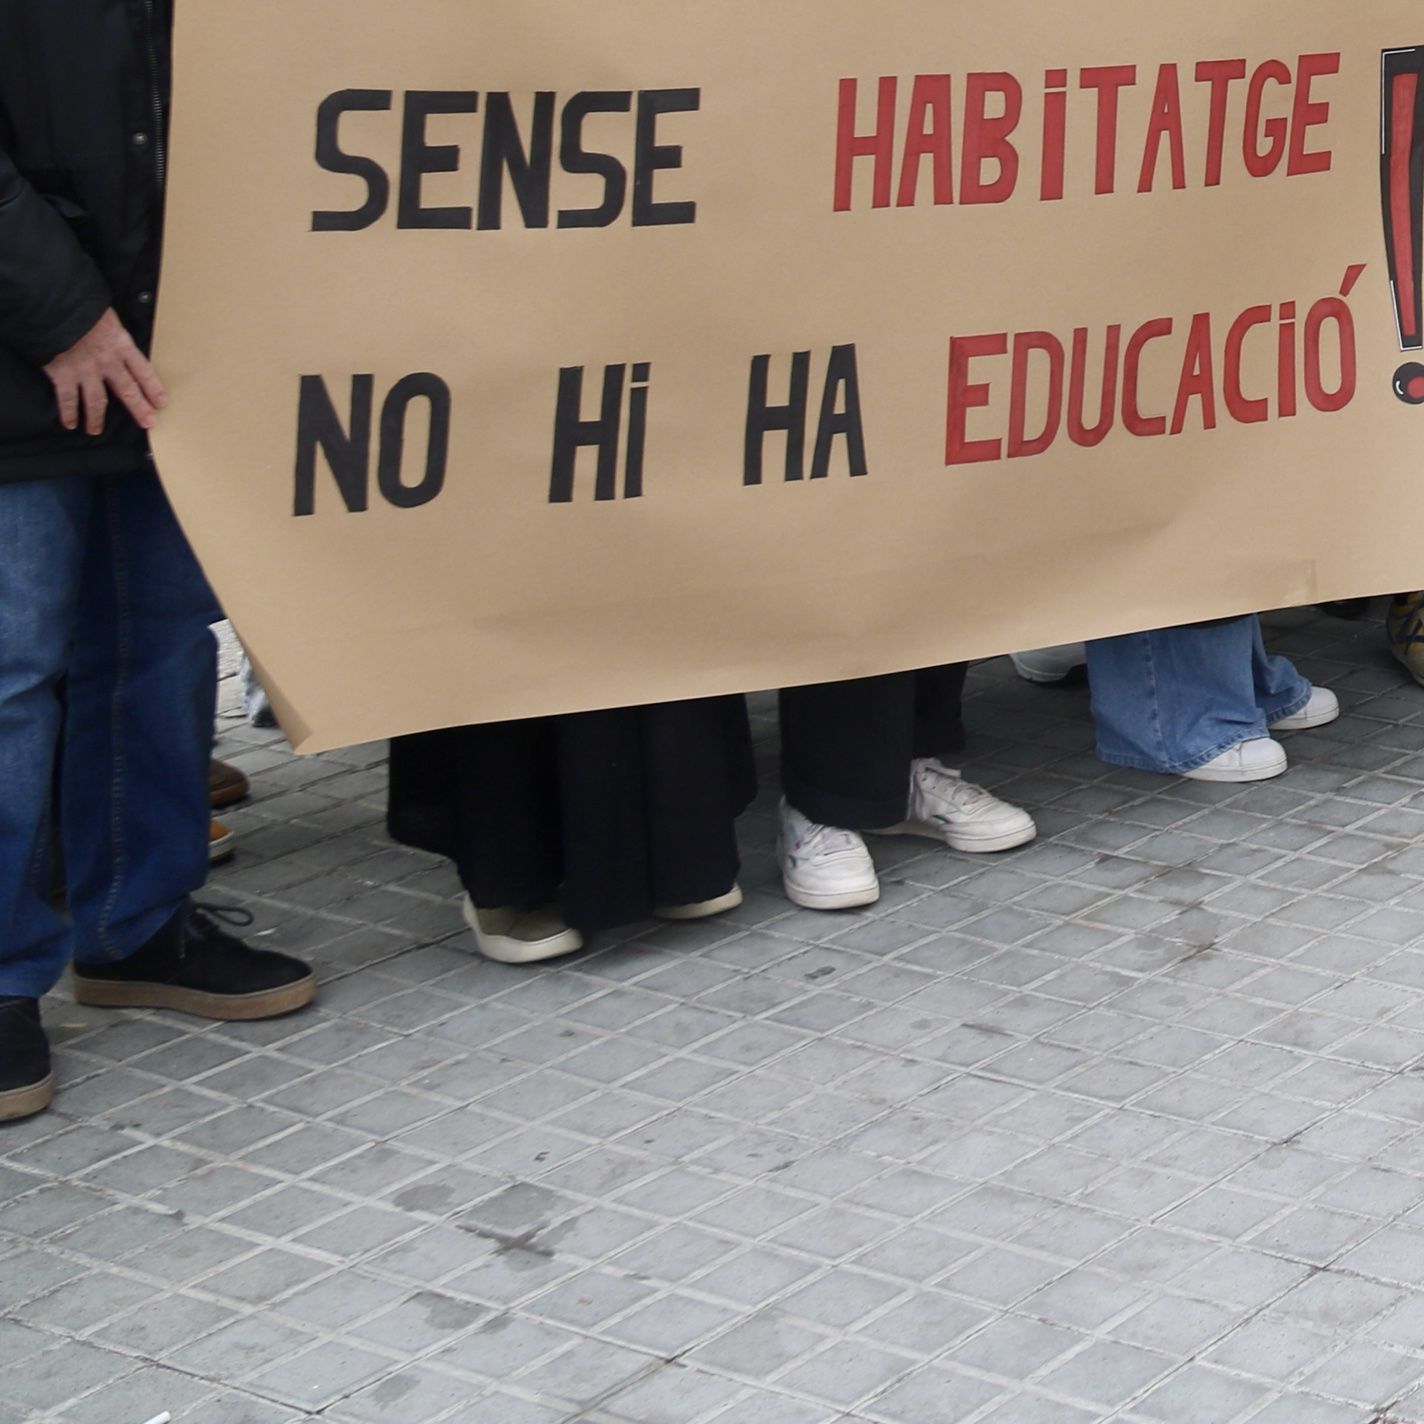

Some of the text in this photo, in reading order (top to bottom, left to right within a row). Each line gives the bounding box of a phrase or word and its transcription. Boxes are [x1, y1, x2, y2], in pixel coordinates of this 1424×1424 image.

[311, 87, 701, 232] SENSE
[292, 372, 452, 517] NO
[743, 343, 868, 486] HA
